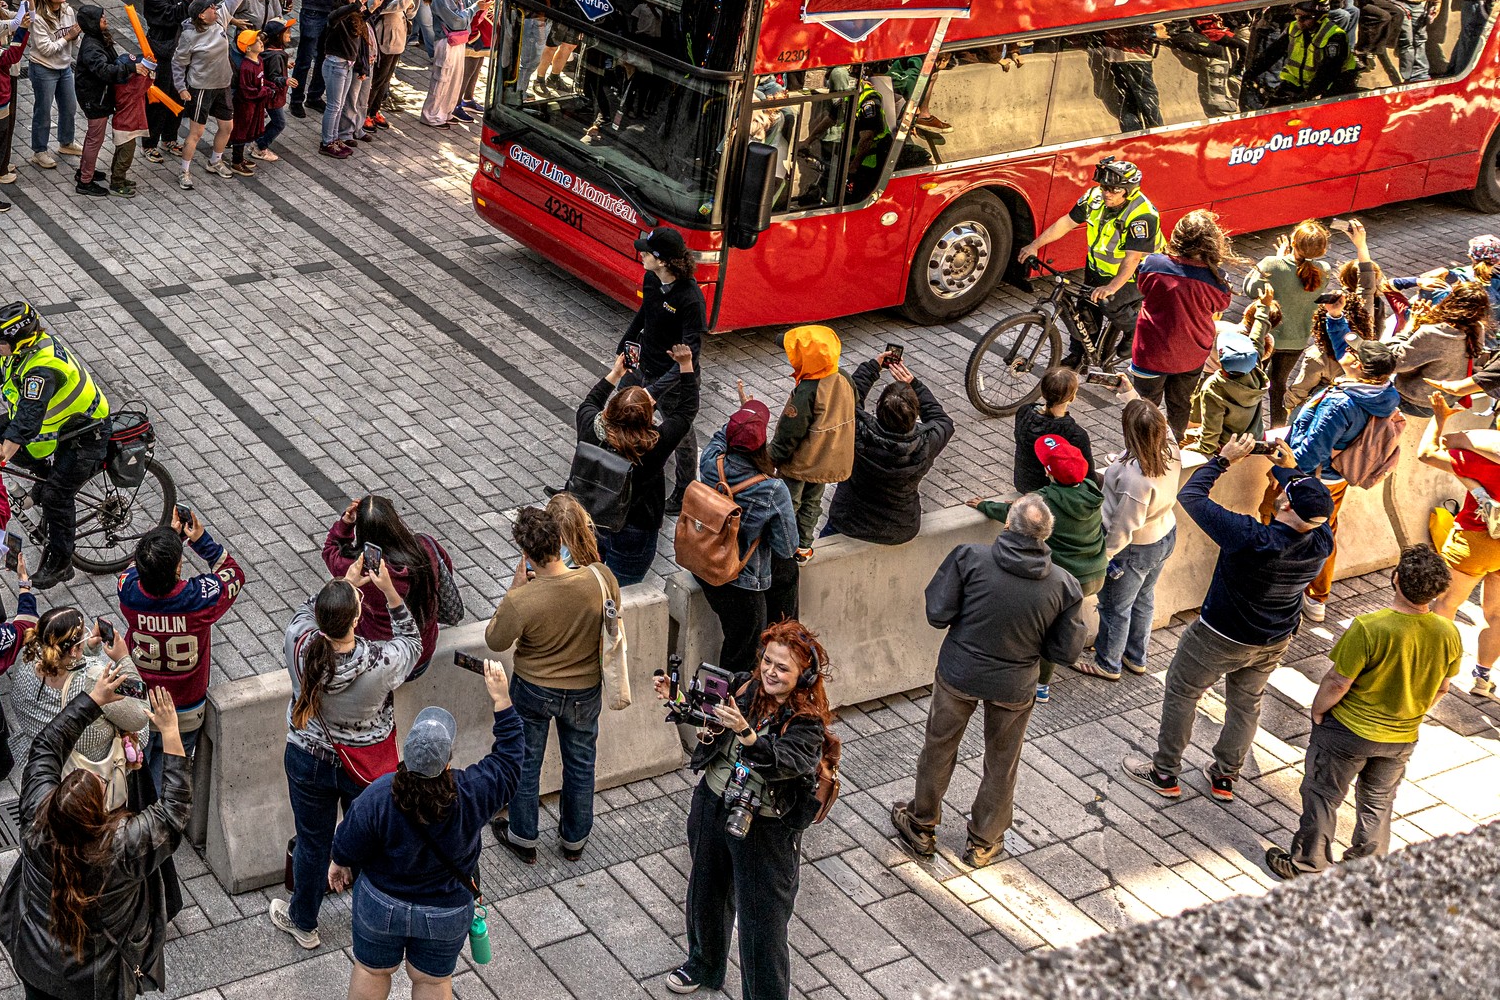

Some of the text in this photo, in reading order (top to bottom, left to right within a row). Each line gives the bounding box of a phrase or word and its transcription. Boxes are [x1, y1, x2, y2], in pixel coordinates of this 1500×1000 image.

[778, 48, 811, 63] 42301
[509, 143, 638, 225] Gray Line Montréal
[544, 196, 584, 232] 42301
[137, 613, 188, 633] POULIN
[131, 631, 200, 672] 29
